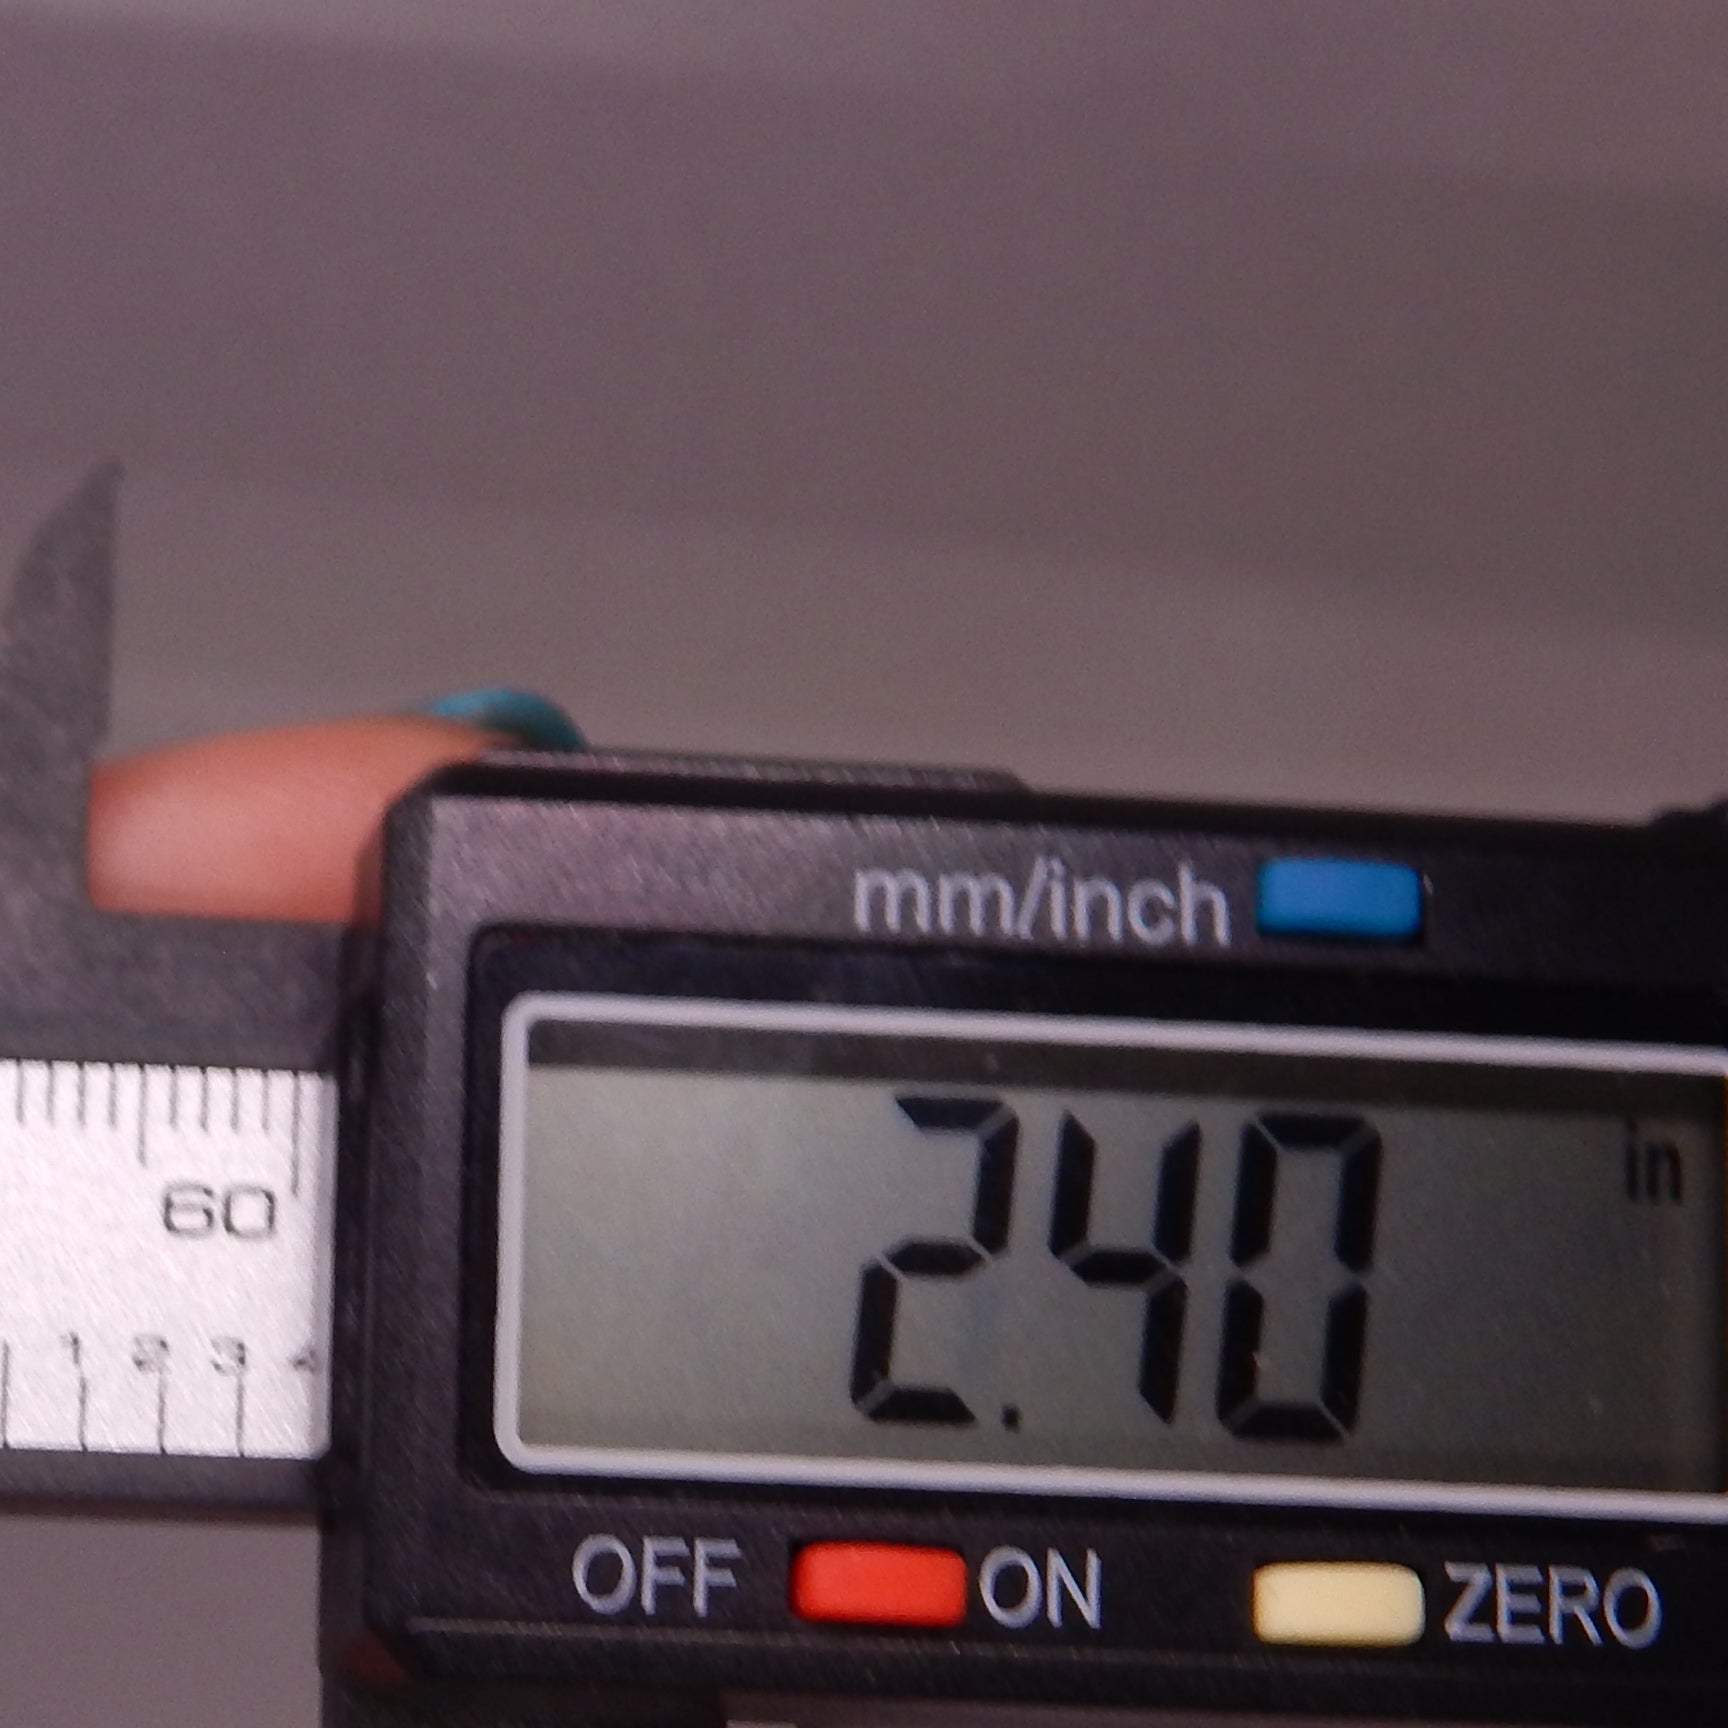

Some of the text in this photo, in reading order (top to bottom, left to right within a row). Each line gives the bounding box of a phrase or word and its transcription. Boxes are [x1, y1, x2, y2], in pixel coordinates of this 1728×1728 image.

[853, 855, 1231, 950] mm/inch
[162, 1184, 278, 1240] 60
[850, 1096, 1684, 1442] 2.40 in
[133, 1337, 171, 1371] 2
[210, 1338, 248, 1375] 3
[572, 1533, 744, 1614] OFF
[978, 1549, 1104, 1630] ON
[1442, 1561, 1661, 1649] ZERO
